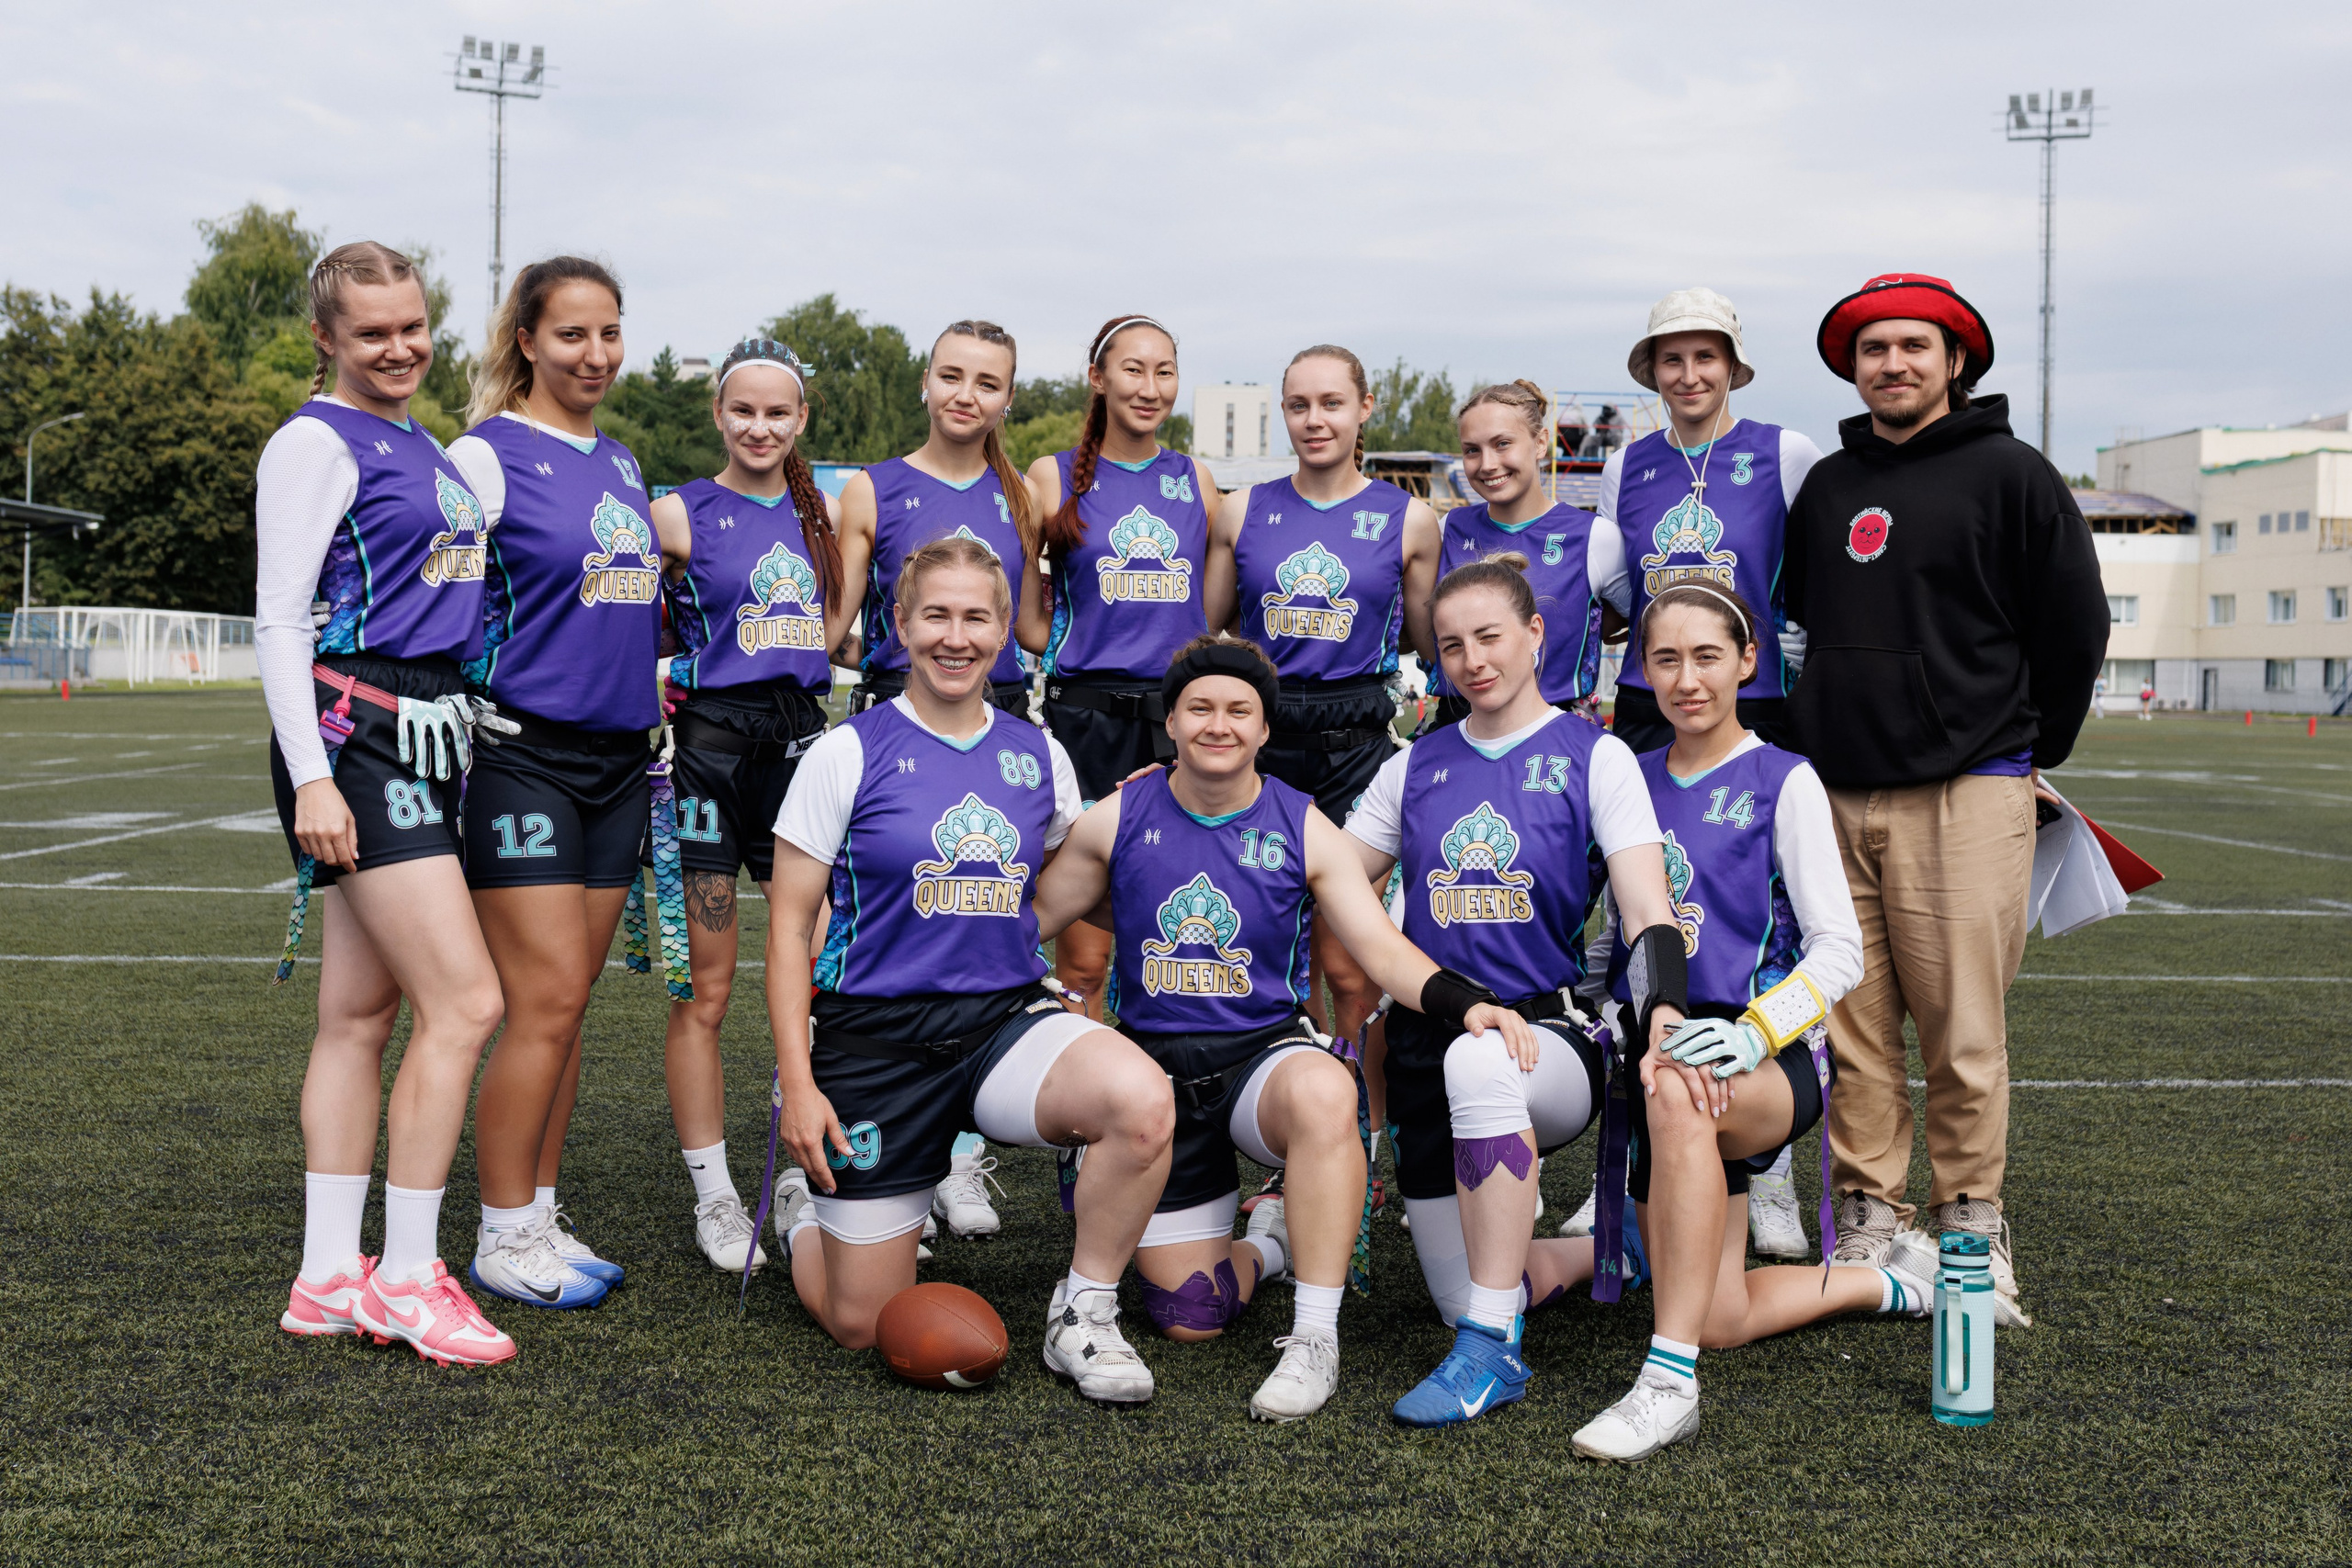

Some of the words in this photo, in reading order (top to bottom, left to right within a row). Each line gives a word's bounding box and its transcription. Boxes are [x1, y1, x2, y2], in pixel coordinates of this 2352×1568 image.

[611, 455, 644, 491] 12
[1730, 453, 1754, 485] 3
[1159, 474, 1194, 503] 66
[993, 491, 1011, 524] 7
[1351, 510, 1389, 541] 17
[1542, 533, 1566, 565] 5
[582, 570, 658, 605] QUEENS
[1101, 572, 1190, 604] QUEENS
[739, 617, 826, 653] QUEENS
[1265, 607, 1352, 642] QUEENS
[997, 749, 1042, 791] 89
[1522, 754, 1571, 795] 13
[384, 778, 443, 829] 81
[678, 796, 721, 843] 11
[1702, 786, 1755, 829] 14
[492, 813, 557, 858] 12
[1238, 828, 1287, 872] 16
[915, 878, 1023, 918] QUEENS
[1430, 887, 1533, 928] QUEENS
[1143, 957, 1251, 997] QUEENS
[1063, 1166, 1077, 1184] 89
[1600, 1258, 1618, 1276] 14
